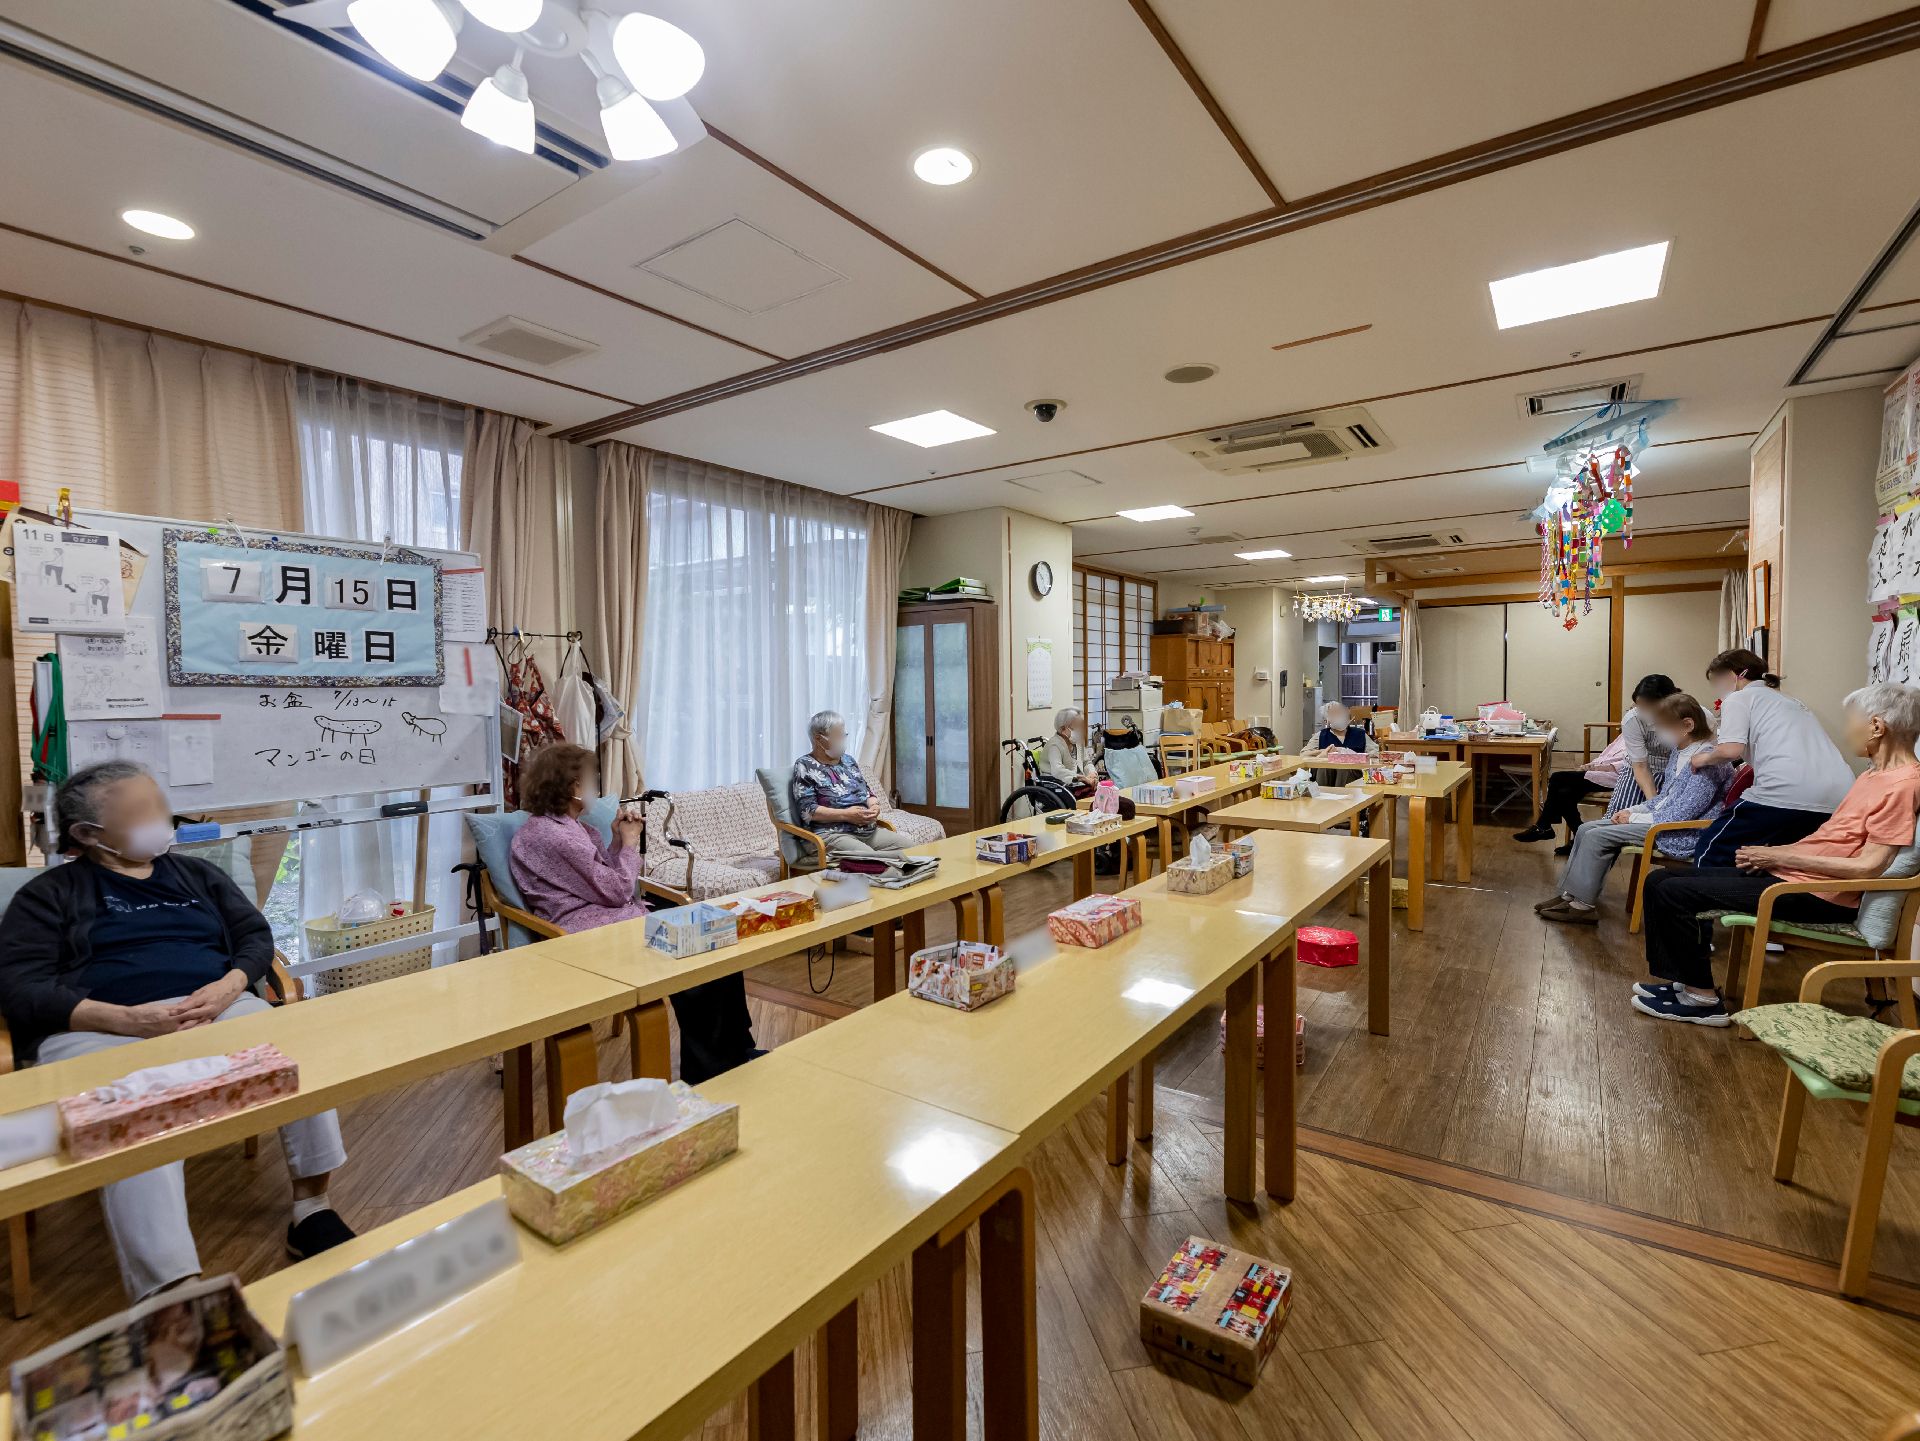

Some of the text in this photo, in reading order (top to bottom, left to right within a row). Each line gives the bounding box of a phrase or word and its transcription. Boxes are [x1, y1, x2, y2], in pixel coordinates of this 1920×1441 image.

[22, 529, 54, 542] 11日
[247, 624, 395, 663] 金曜日
[259, 692, 312, 709] お盆
[255, 748, 376, 767] マンゴーの日
